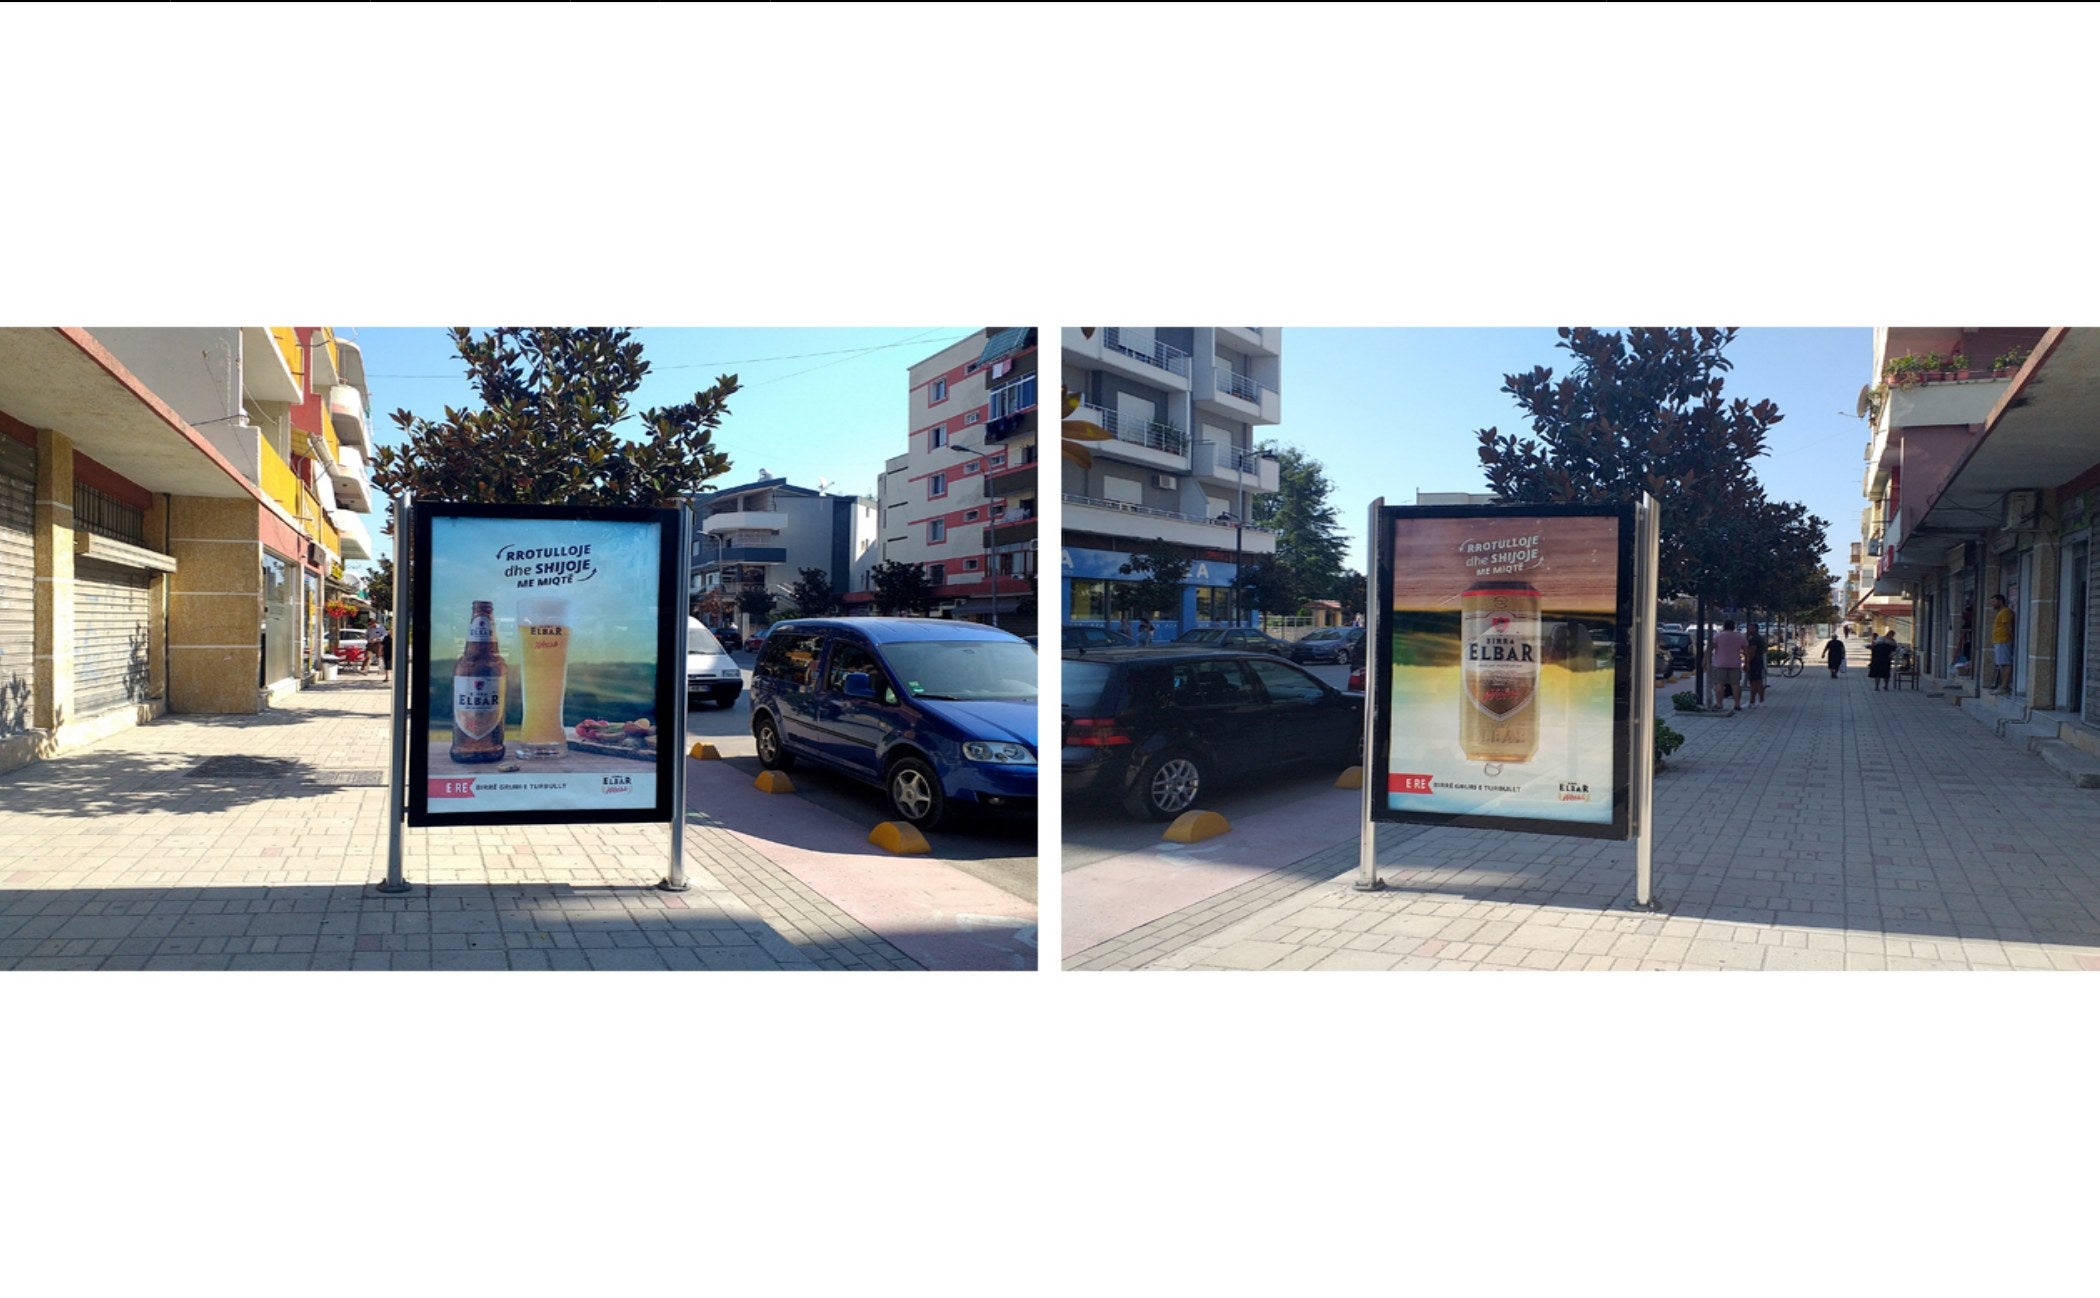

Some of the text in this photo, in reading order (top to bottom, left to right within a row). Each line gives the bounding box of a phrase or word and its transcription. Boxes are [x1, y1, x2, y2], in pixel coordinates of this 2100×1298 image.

[1467, 535, 1539, 553] RROTULLOJE
[506, 543, 592, 561] RROTULLOJE
[1465, 549, 1539, 567] dhe SHIJOJE
[504, 559, 591, 577] dhe SHIJOJE
[1476, 567, 1491, 576] ME
[517, 579, 535, 588] ME
[530, 626, 562, 636] ELBAR
[1469, 643, 1535, 663] ELBAR
[458, 694, 499, 706] ELBAR
[603, 776, 632, 785] ELBAR
[1405, 778, 1427, 790] E RE
[445, 783, 469, 794] E RE
